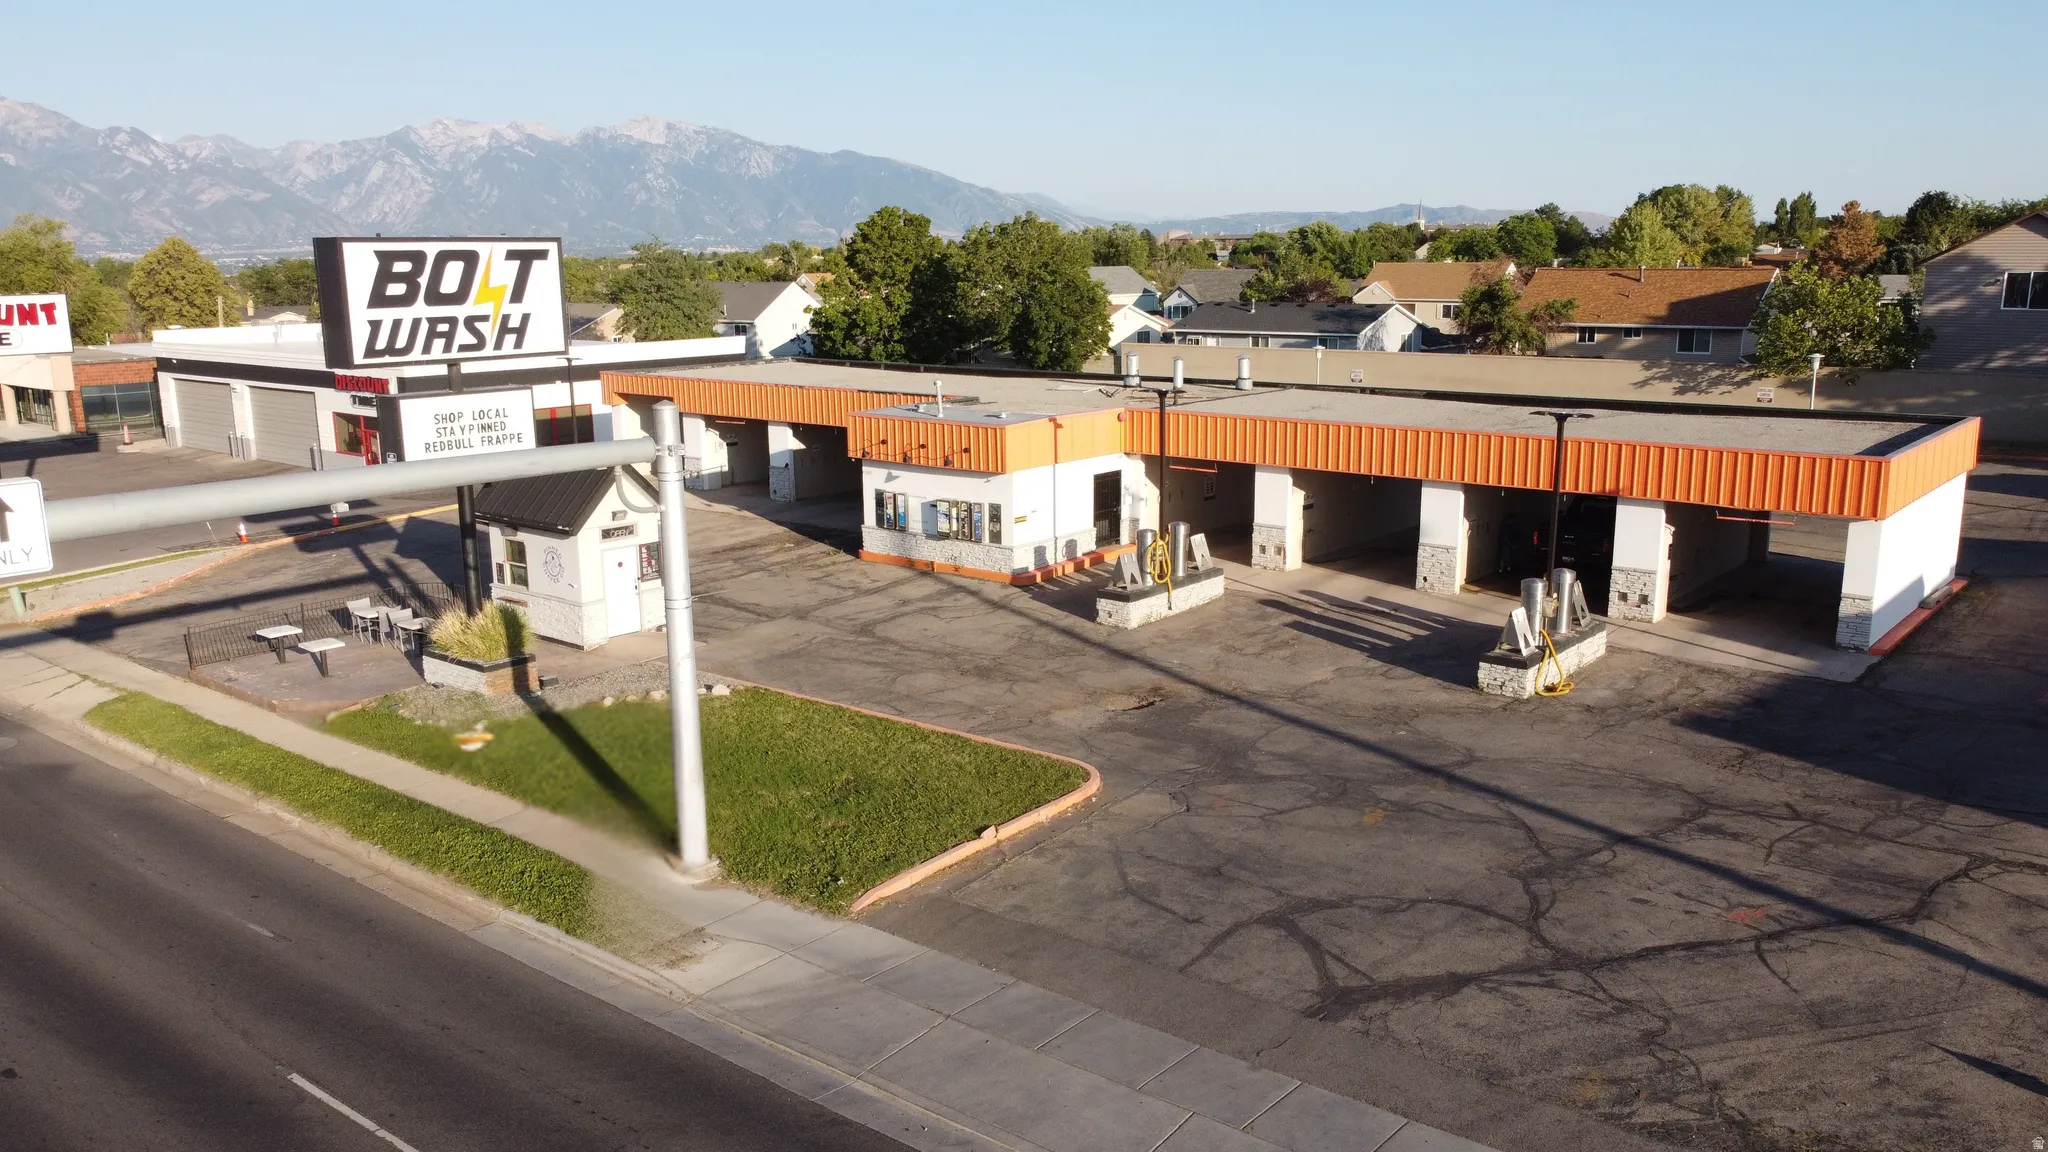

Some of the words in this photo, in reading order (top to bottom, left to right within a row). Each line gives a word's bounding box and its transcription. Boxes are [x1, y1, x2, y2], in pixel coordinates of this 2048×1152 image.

[367, 246, 550, 309] BOLT
[363, 312, 531, 360] WASH
[334, 374, 389, 394] DISCOUNT
[434, 412, 464, 425] SHOP
[472, 408, 509, 421] LOCAL
[424, 438, 475, 453] REDBULL
[481, 432, 523, 447] FRAPPE
[610, 529, 629, 538] OPEN
